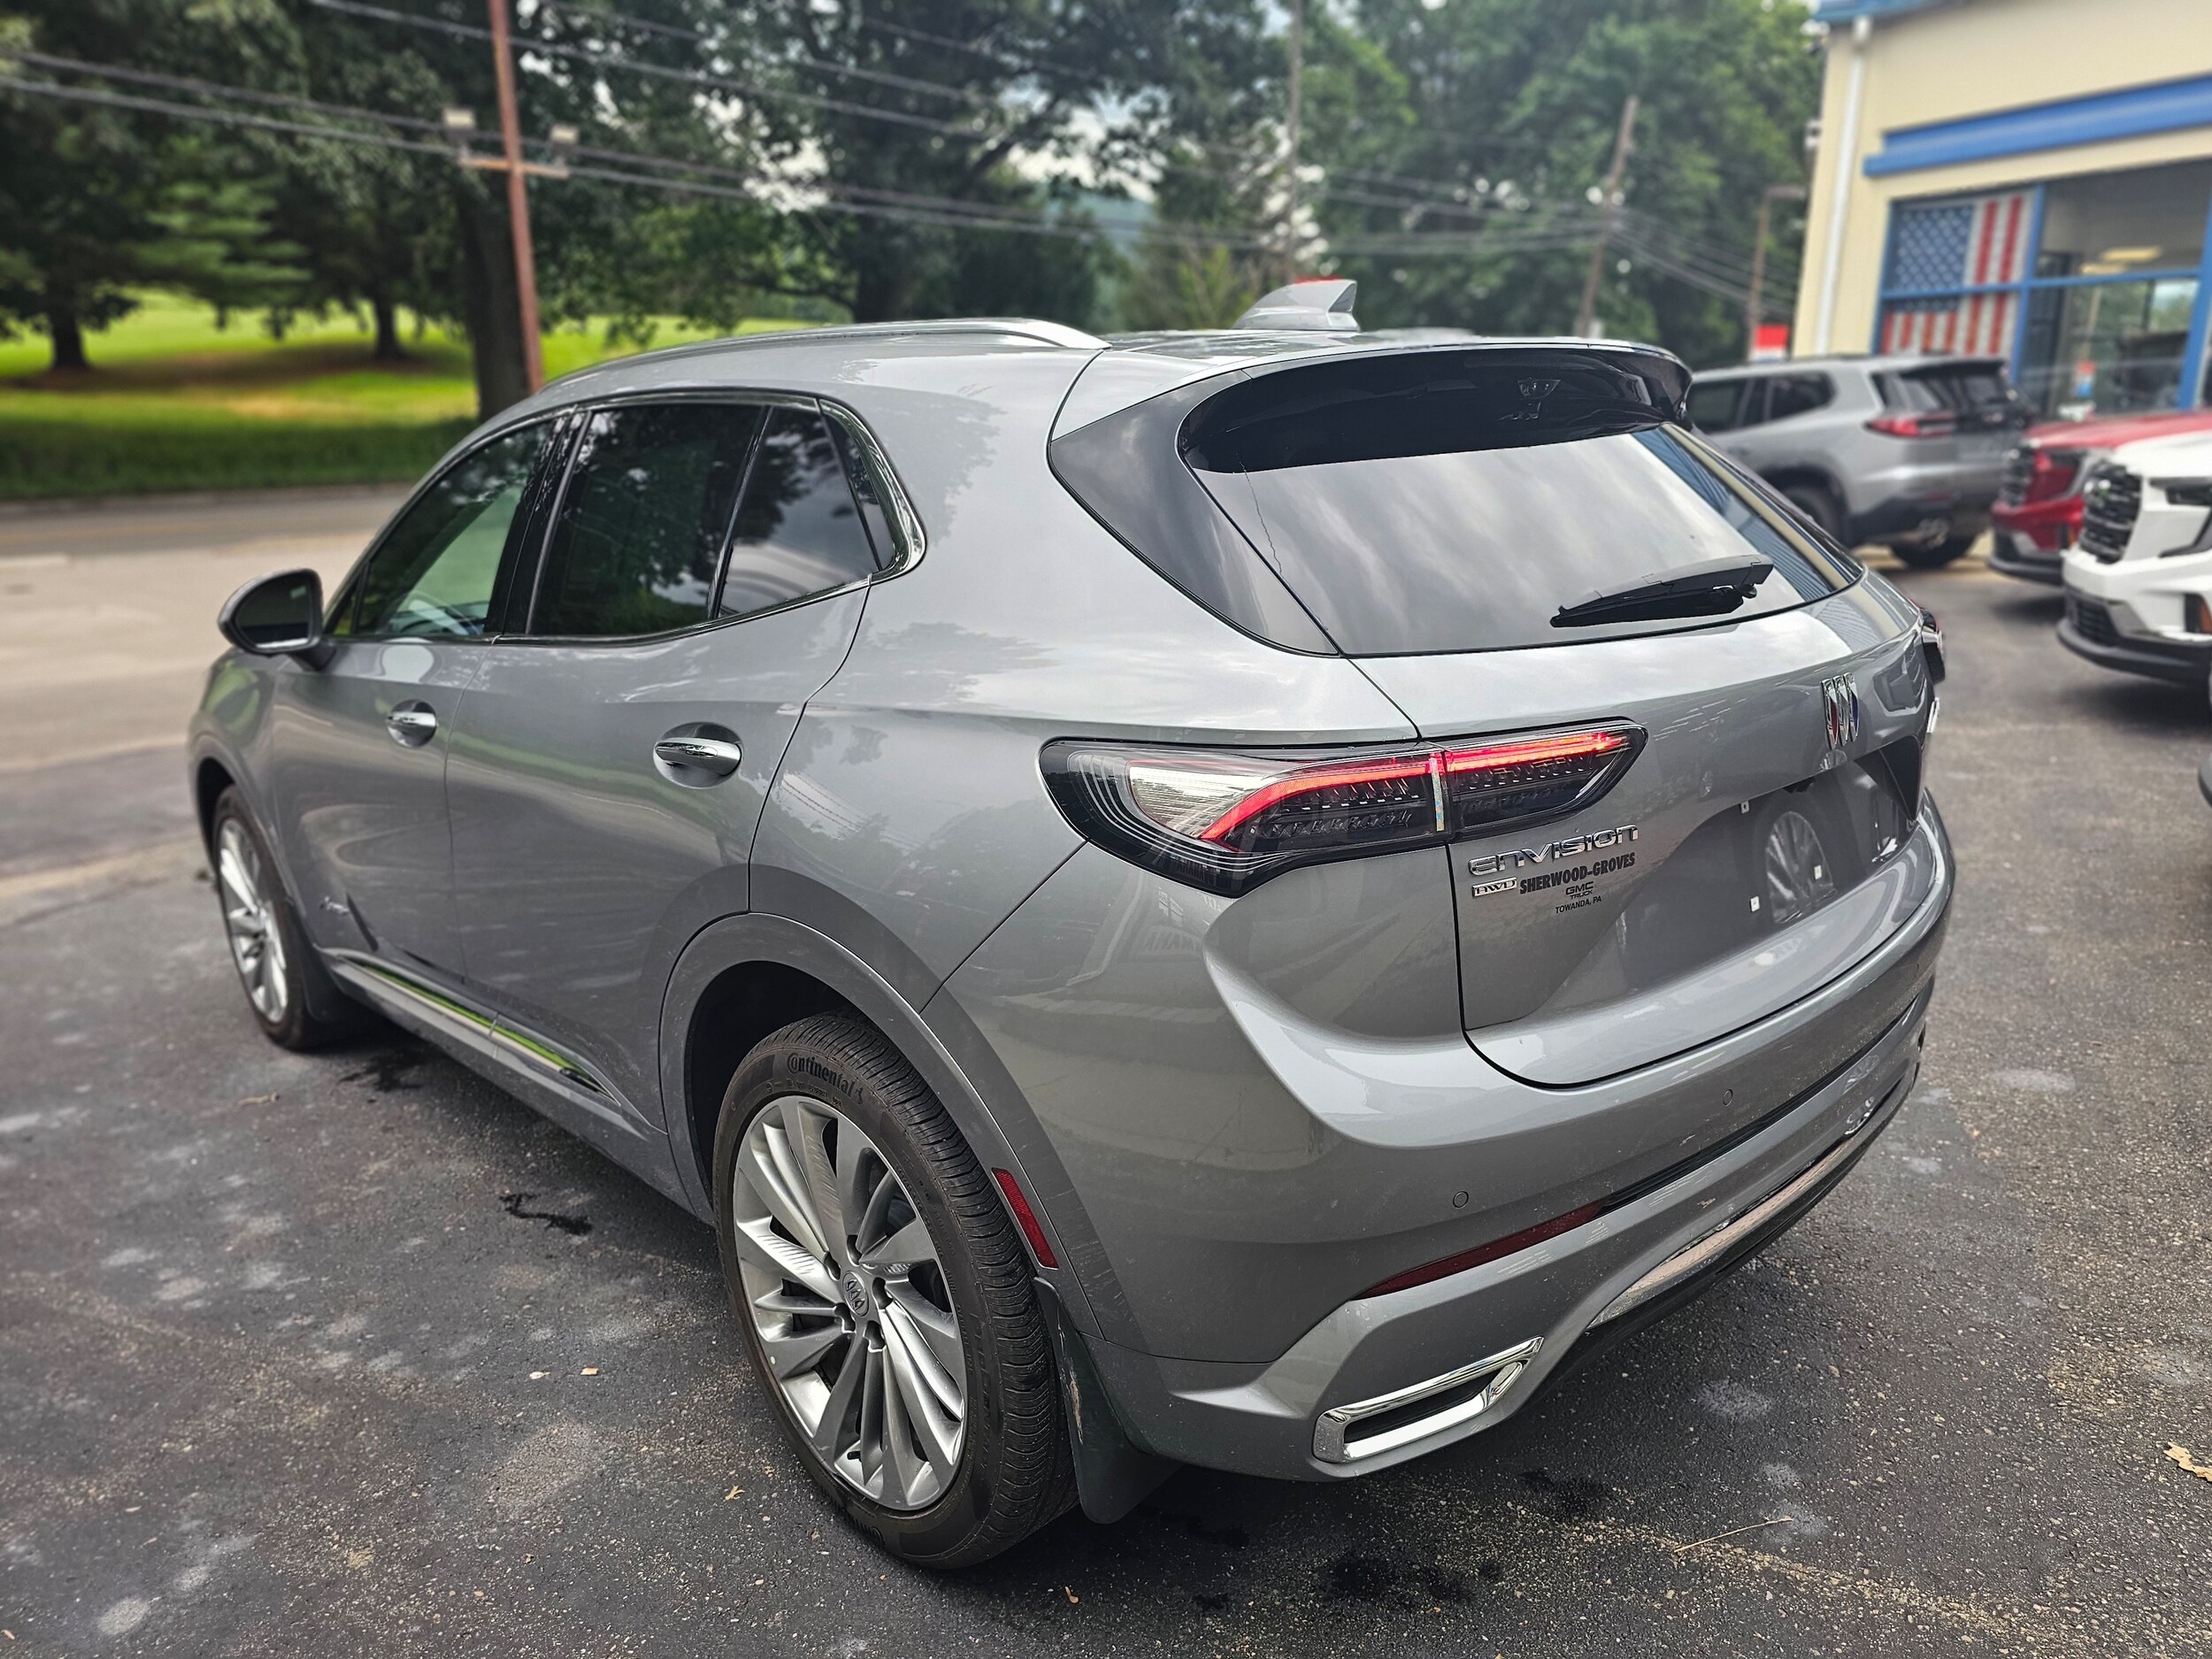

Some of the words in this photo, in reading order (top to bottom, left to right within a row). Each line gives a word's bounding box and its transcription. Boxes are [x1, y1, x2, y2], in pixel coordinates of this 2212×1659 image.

[1520, 852, 1635, 894] SHERWOOD-GROVES
[1474, 878, 1517, 896] AWD
[1565, 881, 1594, 895] GMC
[1570, 889, 1593, 899] TRUCK
[1555, 899, 1592, 914] TOWANDA,
[787, 1052, 856, 1096] Continental
